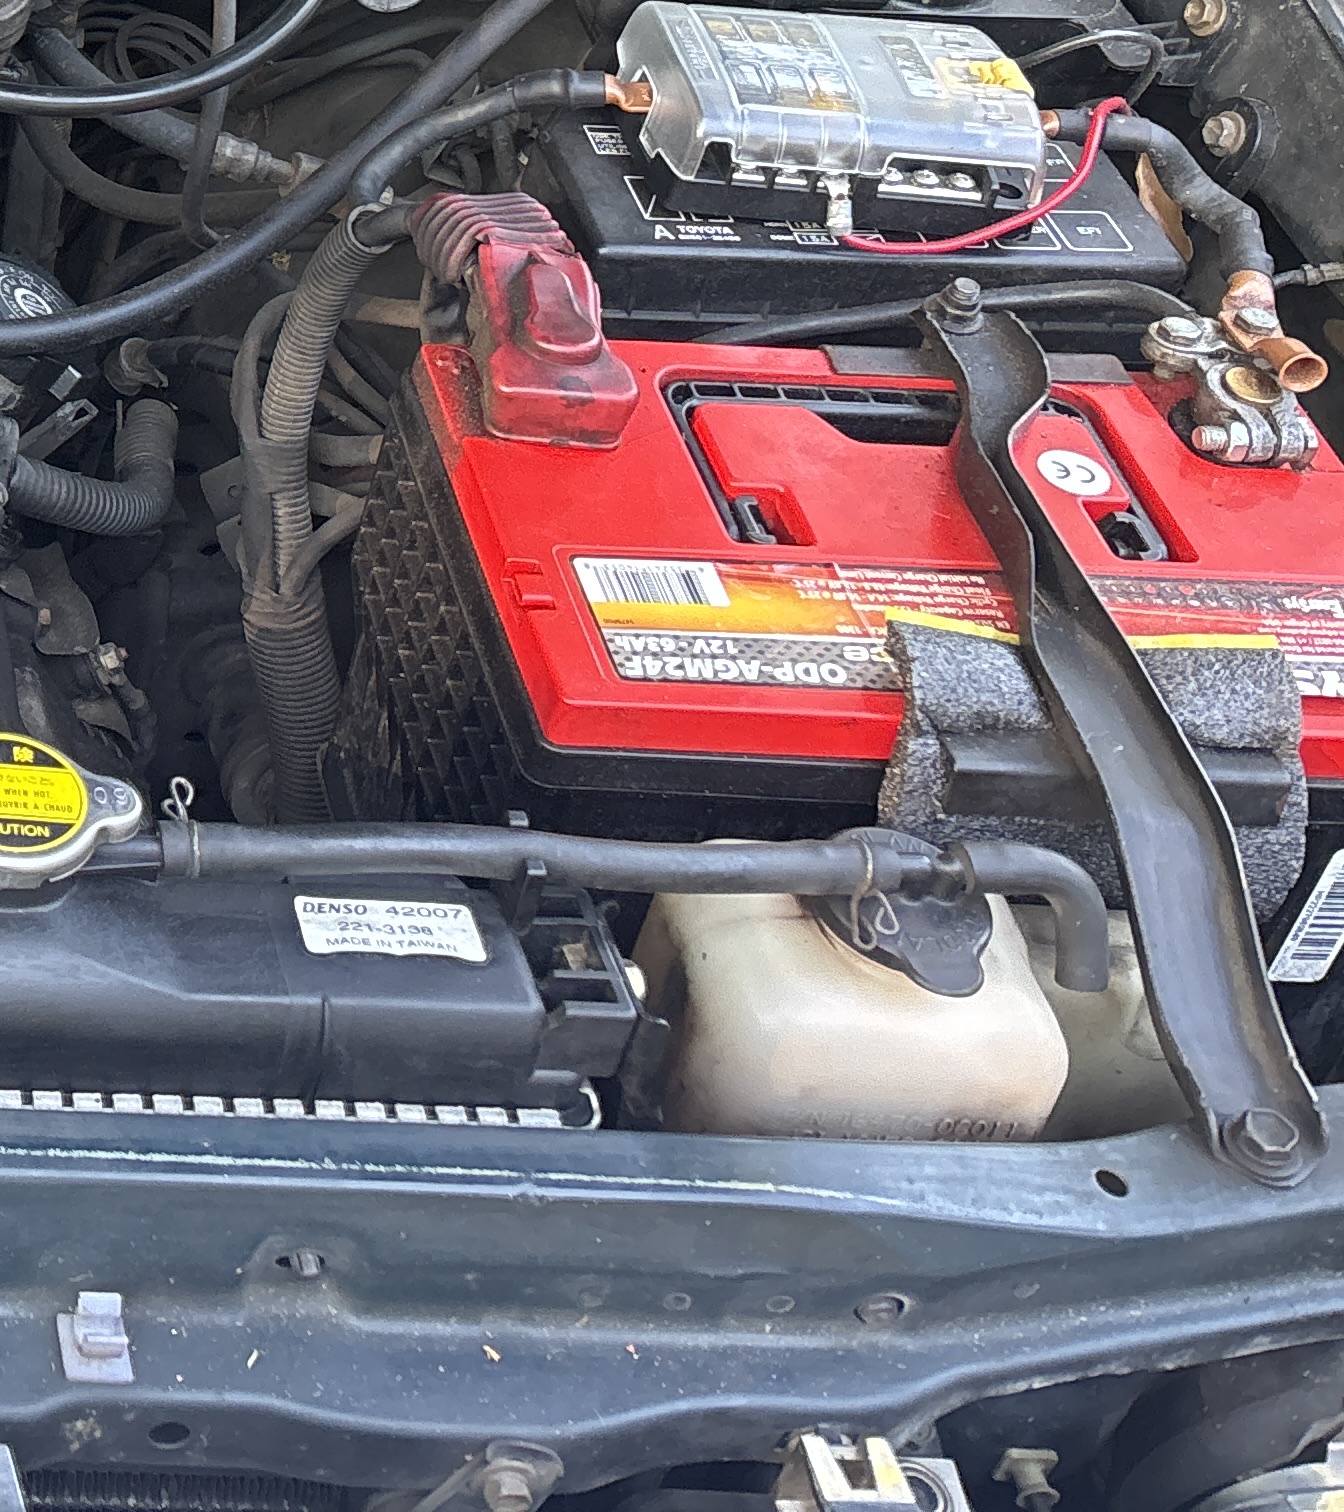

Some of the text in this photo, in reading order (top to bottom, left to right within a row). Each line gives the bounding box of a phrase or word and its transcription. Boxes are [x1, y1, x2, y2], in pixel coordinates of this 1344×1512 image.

[676, 225, 735, 234] TOYOTA
[614, 635, 674, 654] 63Ah
[693, 638, 739, 654] 12V
[624, 656, 848, 685] ODP-AGM24F
[4, 787, 29, 797] WHEN
[44, 803, 74, 814] CHAUD
[302, 901, 463, 920] DENSO 42007
[325, 937, 458, 953] MADE IN TAIWAN
